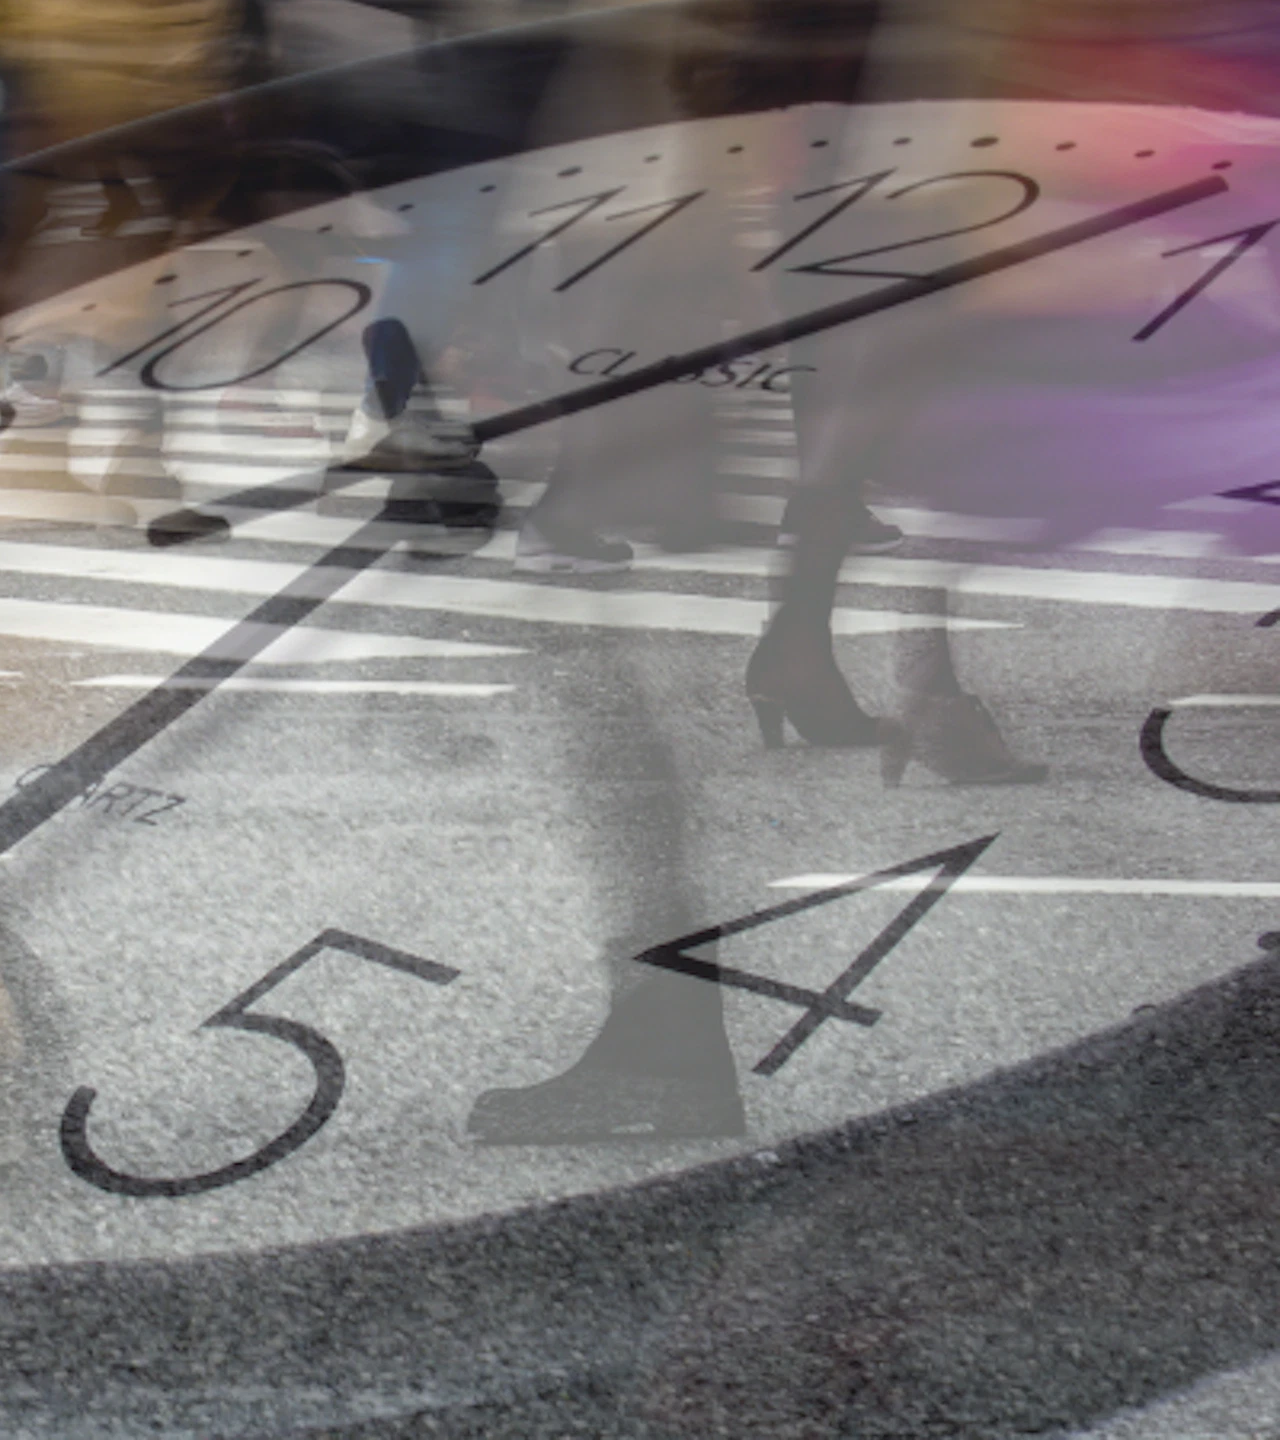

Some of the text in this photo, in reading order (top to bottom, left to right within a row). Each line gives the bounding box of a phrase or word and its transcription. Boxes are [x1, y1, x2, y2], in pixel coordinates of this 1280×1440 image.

[472, 184, 710, 292] 11
[749, 166, 1040, 283] 12
[95, 277, 371, 392] 10
[630, 830, 1001, 1076] 4
[57, 926, 464, 1199] 5
